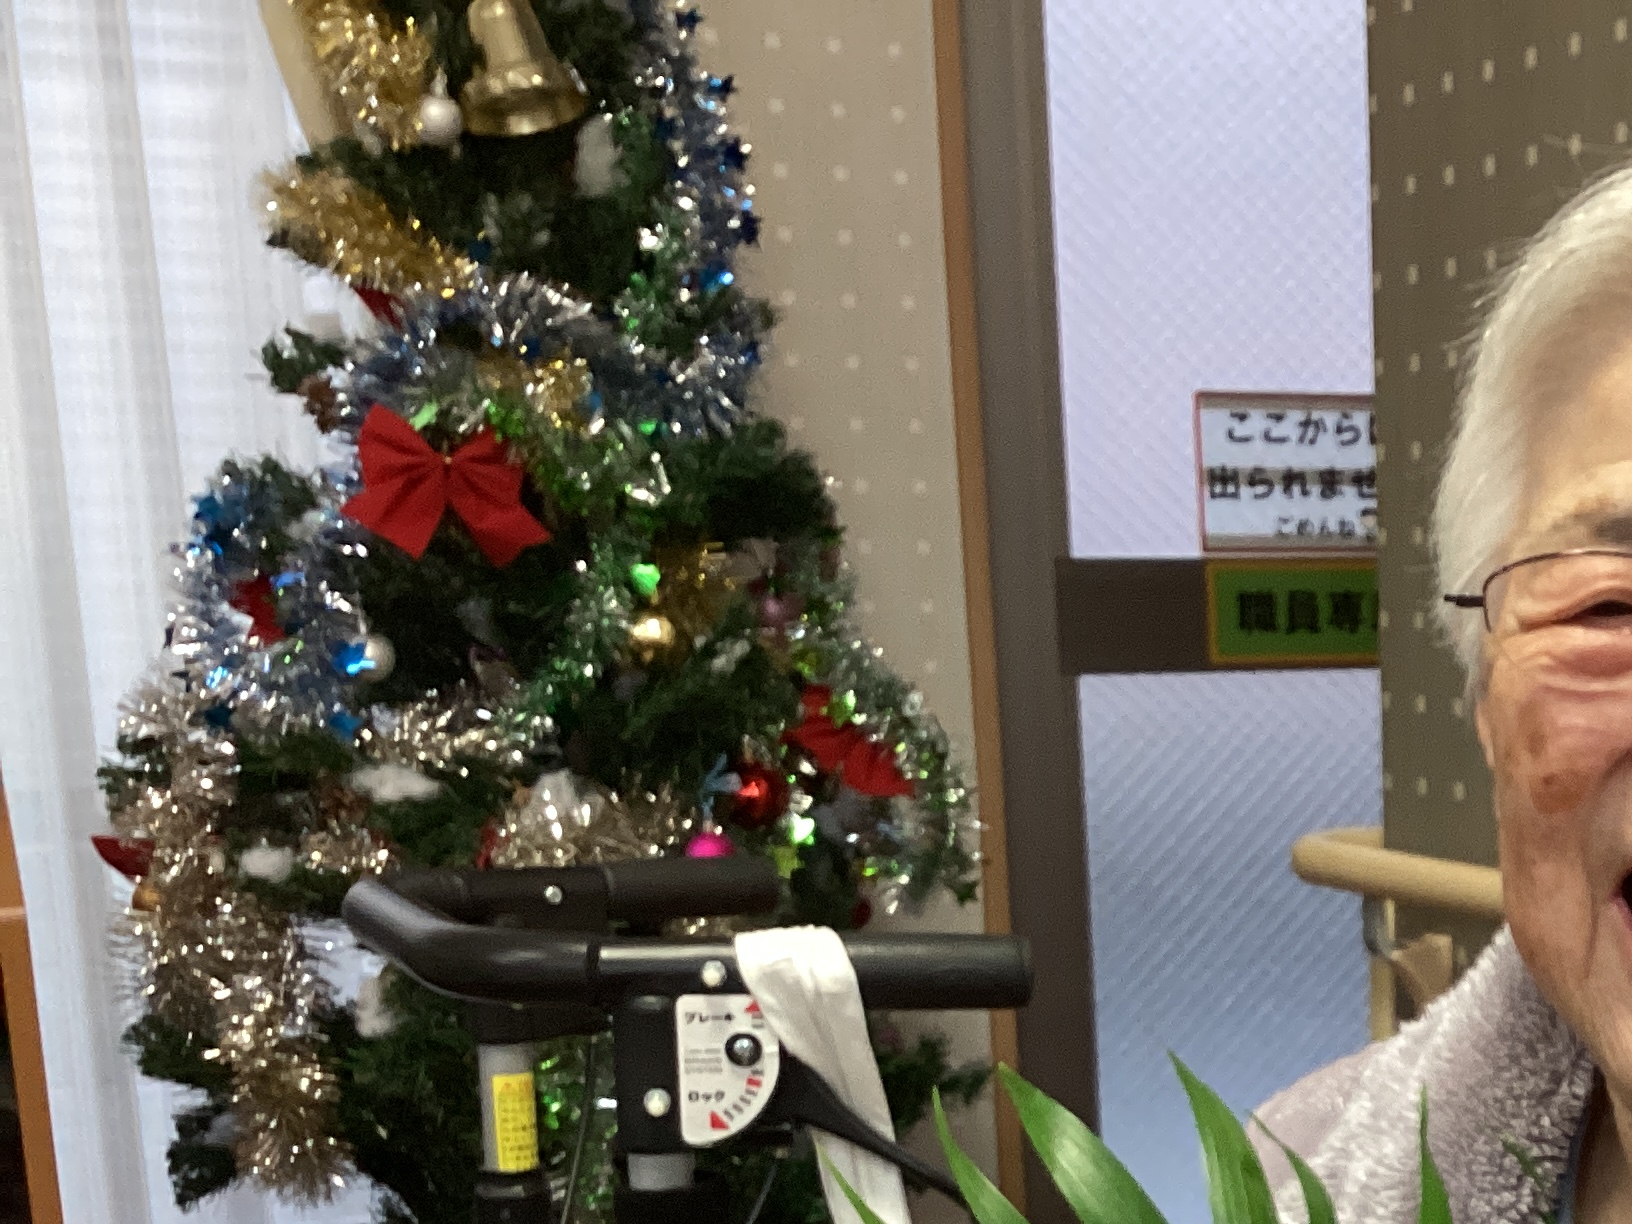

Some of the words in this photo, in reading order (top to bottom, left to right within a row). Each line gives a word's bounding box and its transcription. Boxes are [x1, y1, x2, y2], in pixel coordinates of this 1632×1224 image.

[1227, 410, 1376, 447] ここから
[1238, 590, 1379, 634] 職員専
[688, 1089, 726, 1103] ロック
